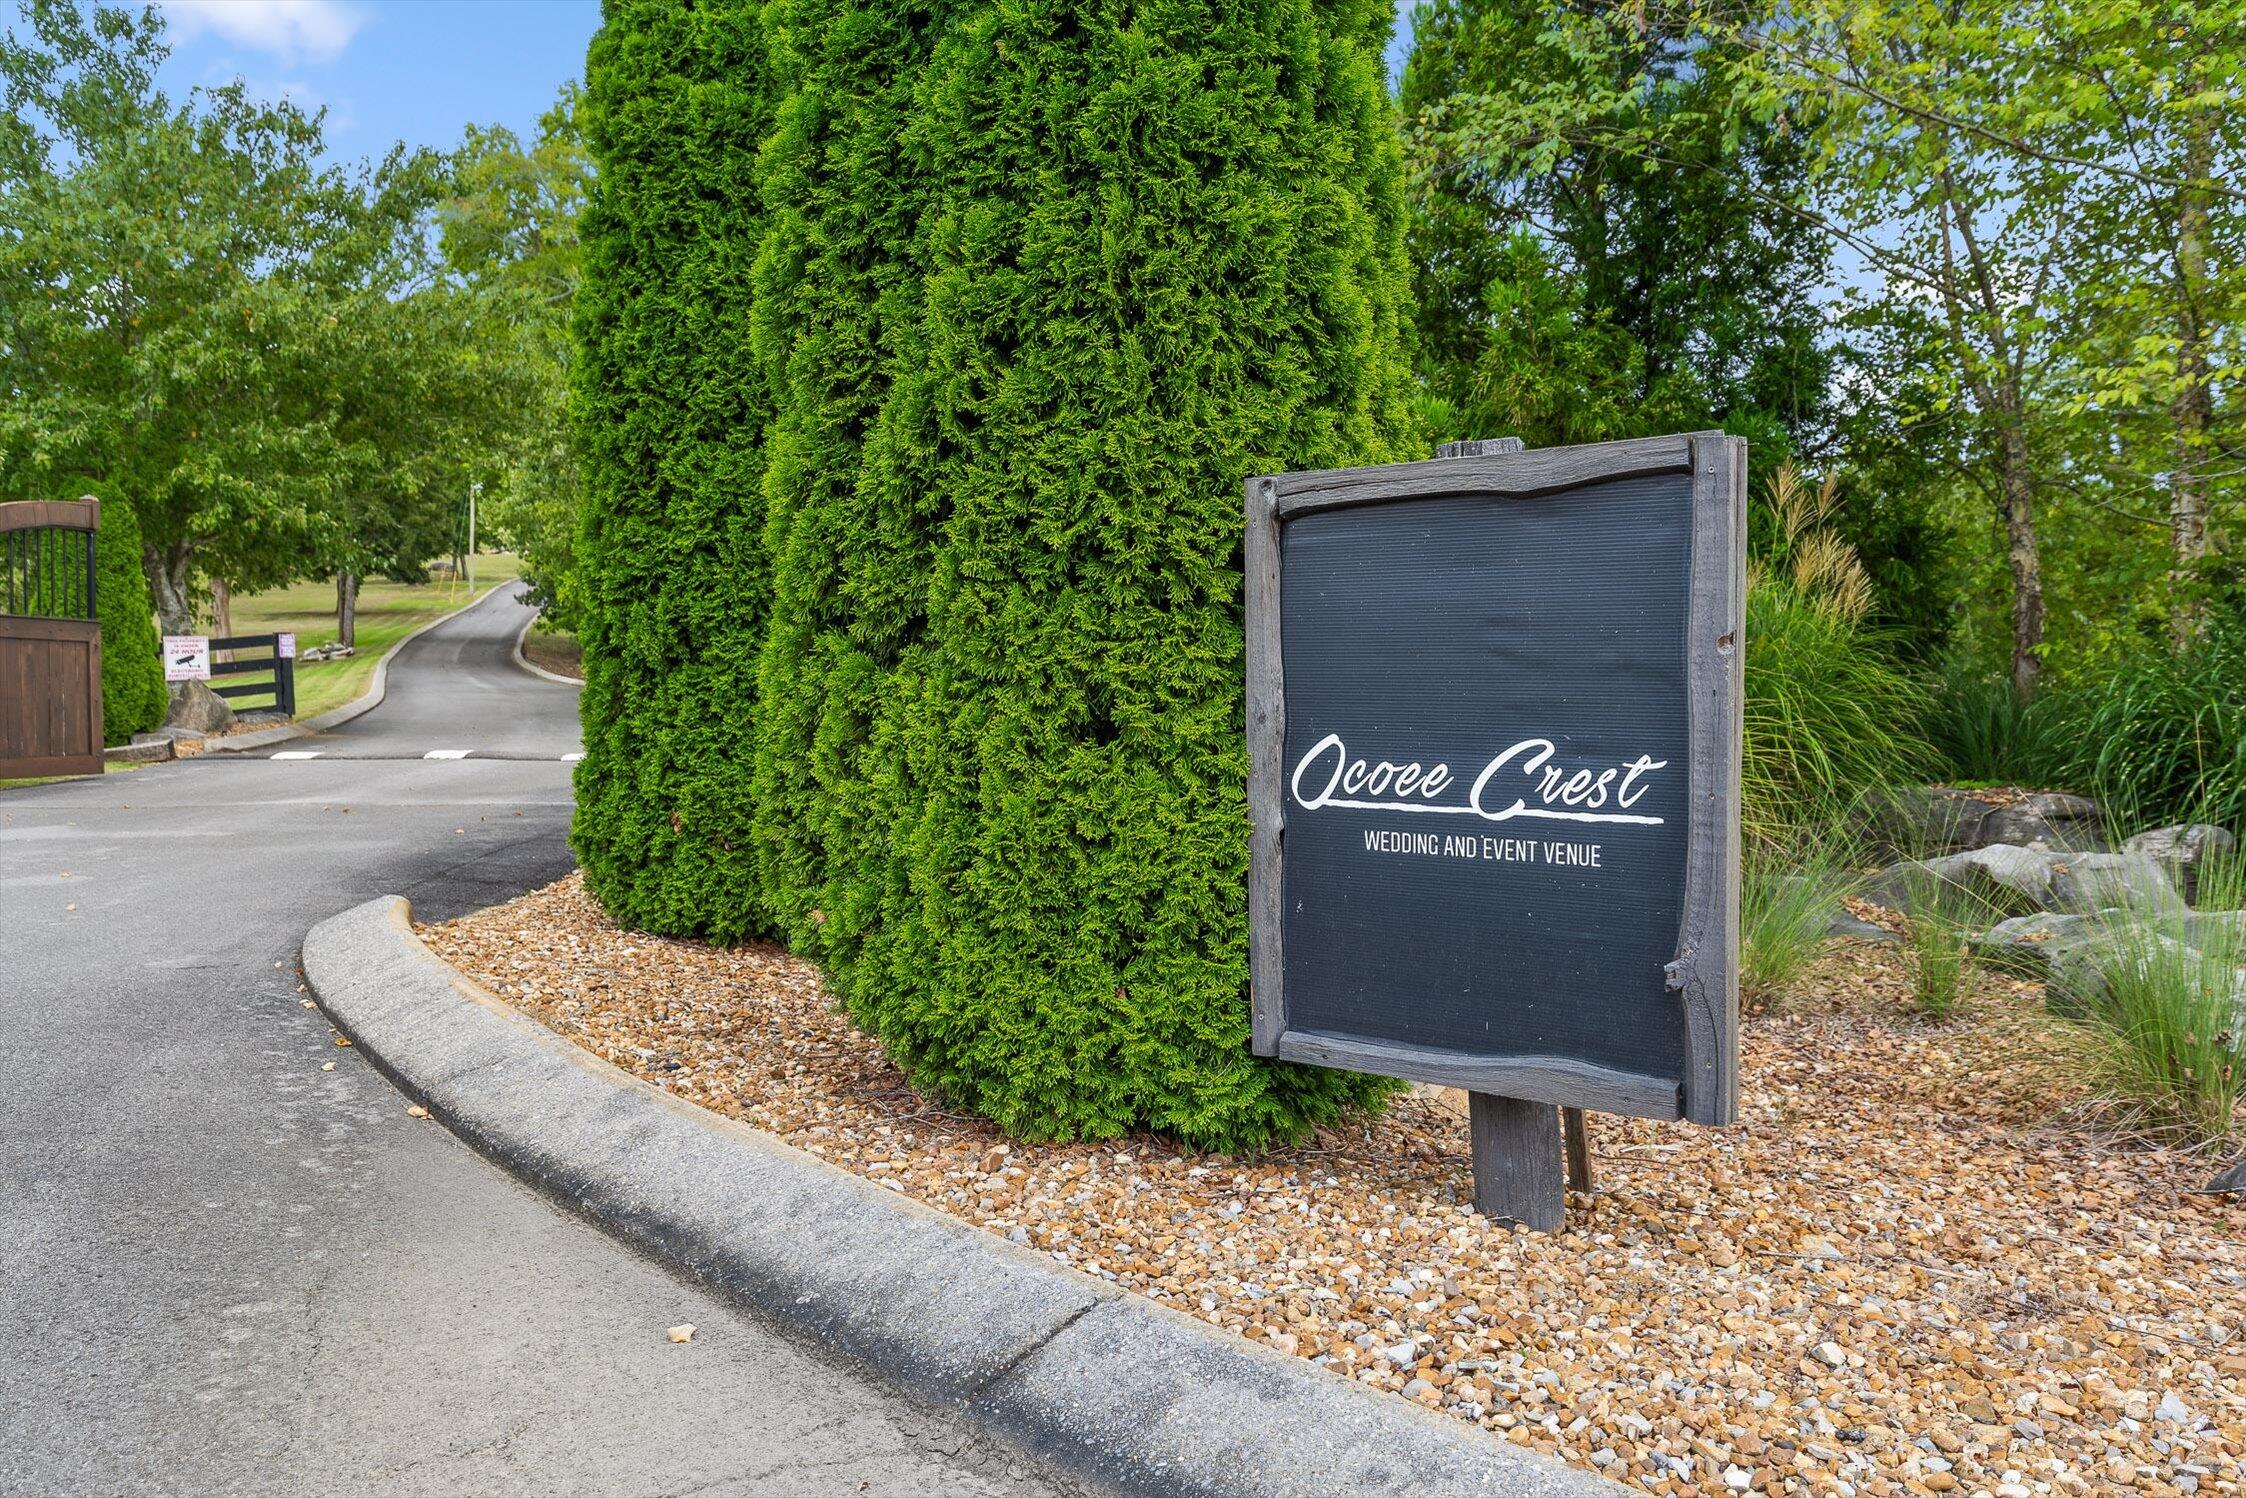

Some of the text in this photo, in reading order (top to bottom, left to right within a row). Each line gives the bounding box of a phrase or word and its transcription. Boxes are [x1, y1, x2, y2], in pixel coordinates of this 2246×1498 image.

[1291, 733, 1668, 820] Ocoee Crest
[1365, 830, 1602, 867] WEDDING AND EVENT VENUE
